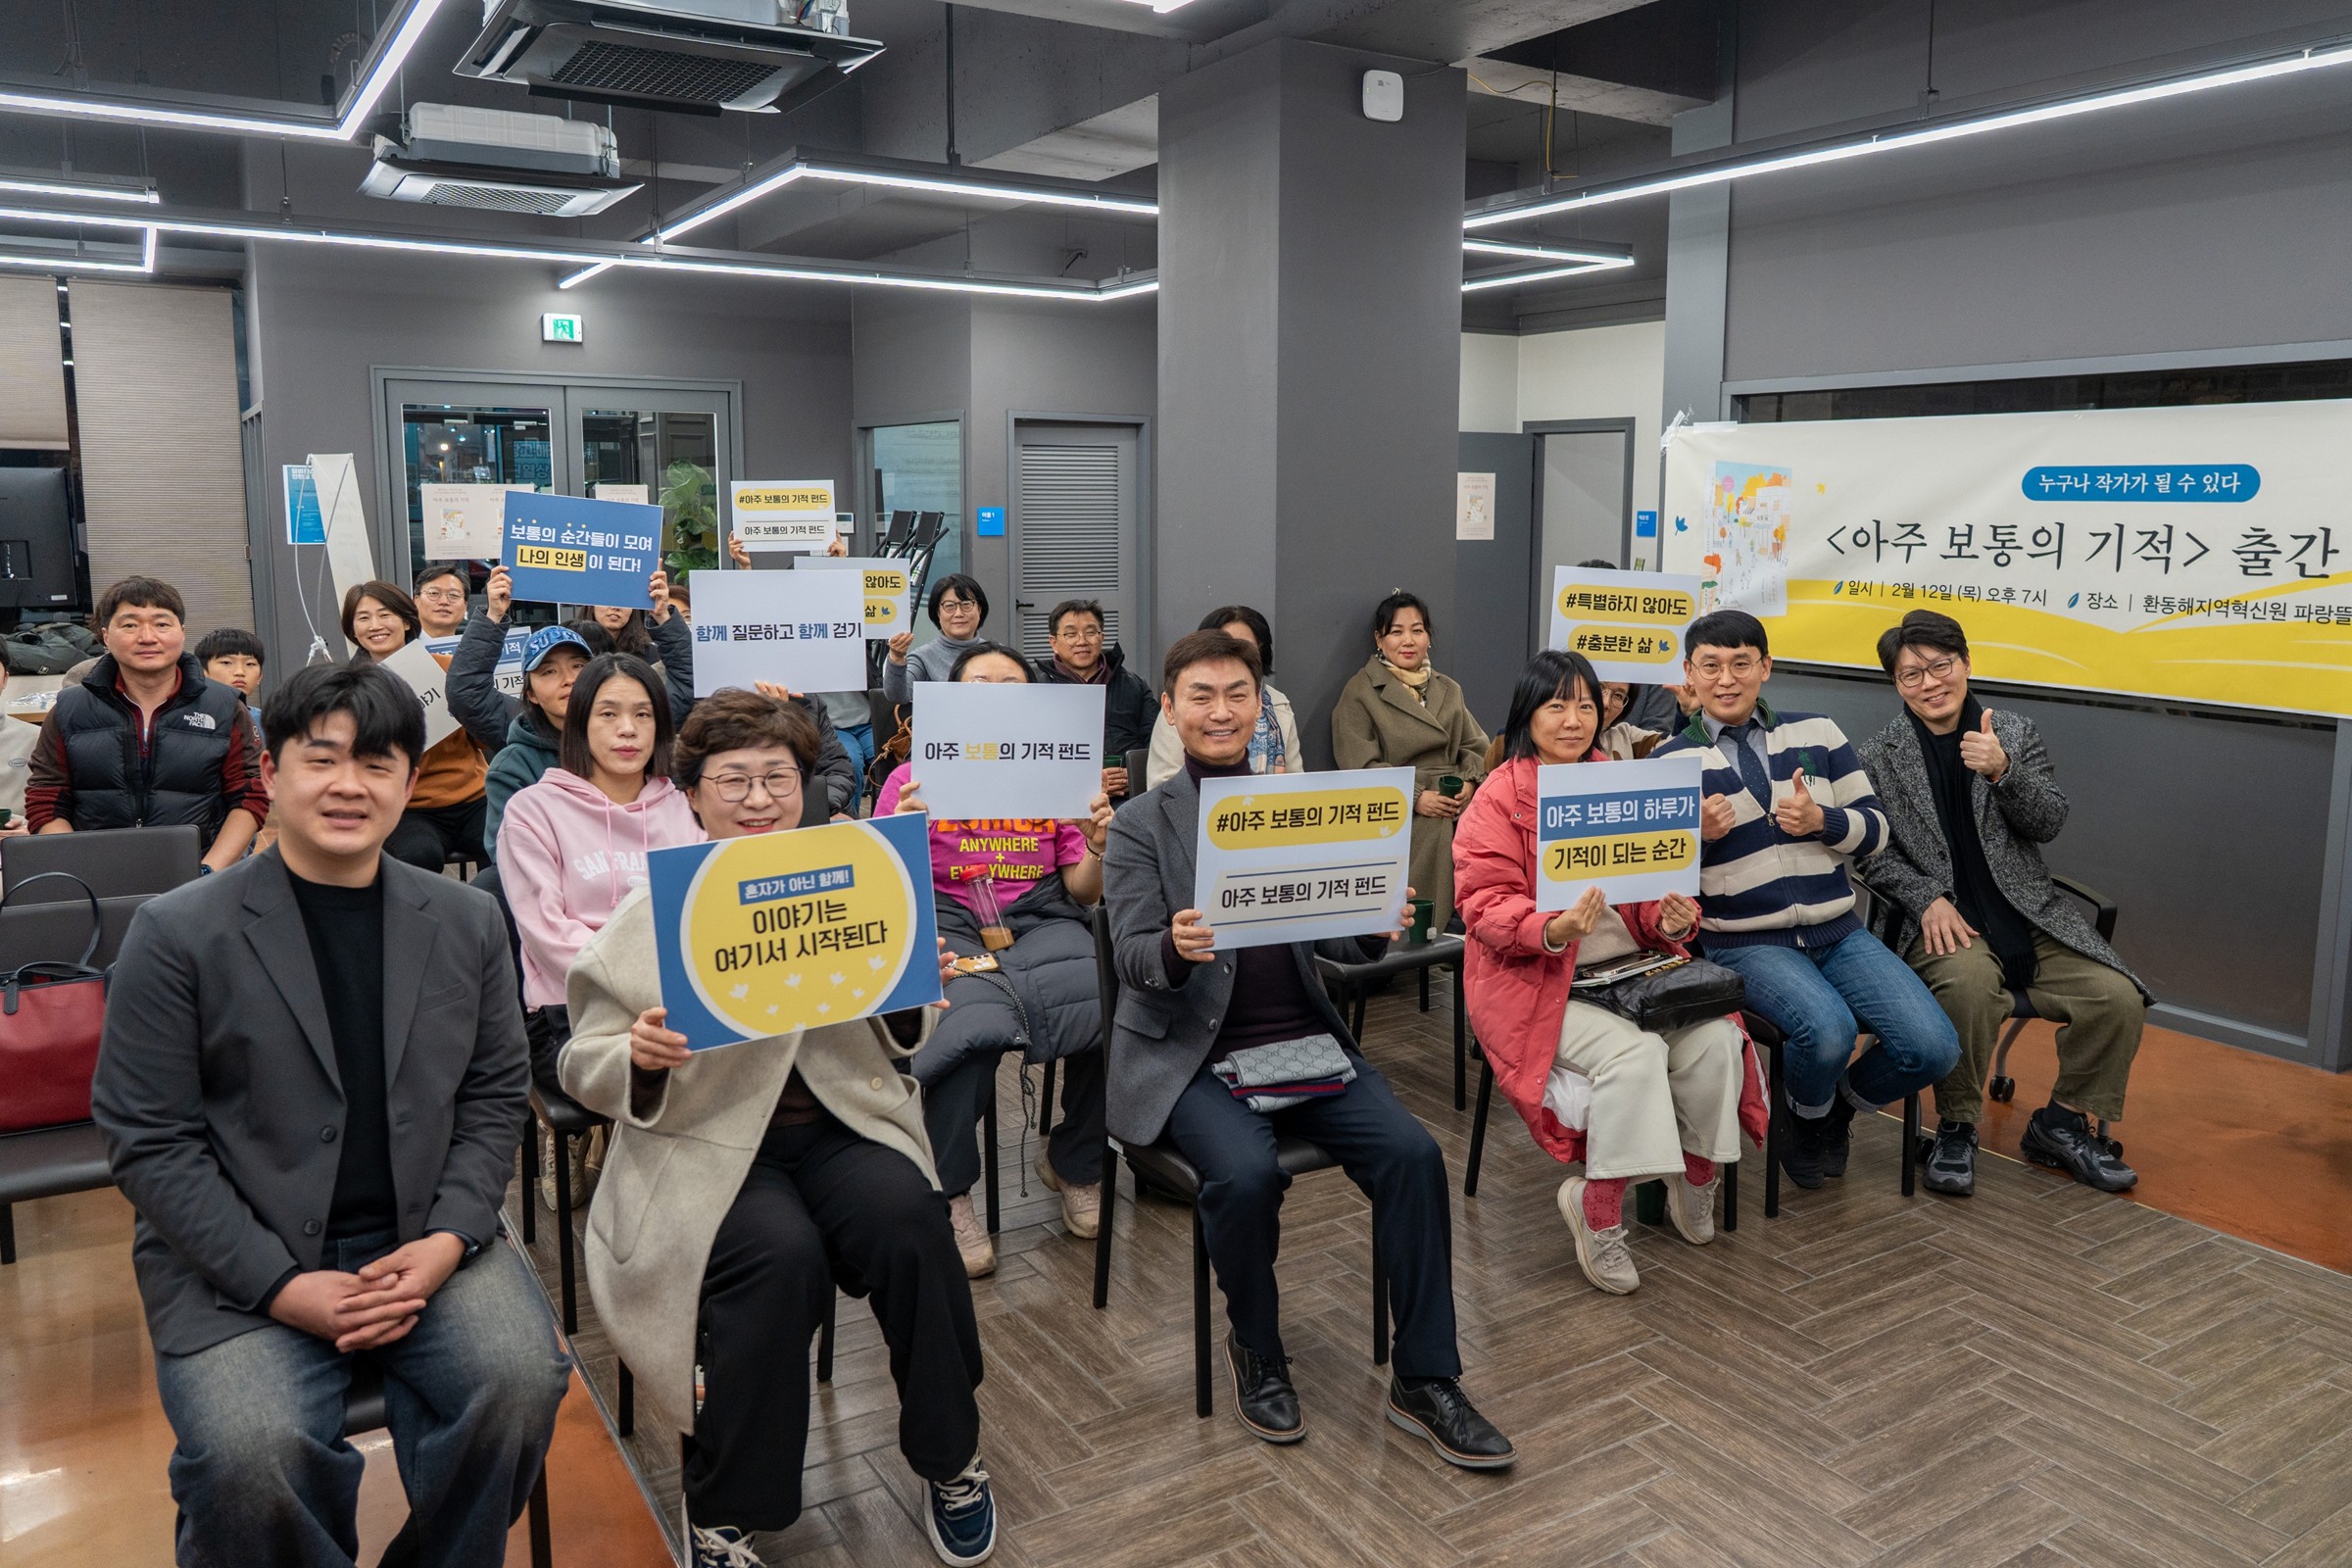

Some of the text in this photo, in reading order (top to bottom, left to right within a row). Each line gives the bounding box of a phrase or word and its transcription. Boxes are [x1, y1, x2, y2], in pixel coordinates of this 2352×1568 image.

[2038, 471, 2241, 494] 누구나 작가가 될 수 있다
[739, 494, 827, 505] #아주 보통의 기적 펀드
[510, 524, 653, 551] 보통의 순간들이 모여
[745, 525, 825, 536] 아주 보통의 기적 펀드
[519, 549, 642, 573] 나의 인생 이 된다!
[1827, 519, 2340, 579] <아주 보통의 기적> 출간
[864, 576, 902, 589] 않아도
[1848, 580, 2047, 606] 일시 2월 12일 (목) 오후 7시
[864, 605, 877, 617] 삶
[1566, 593, 1638, 612] #특별하지
[1642, 597, 1688, 615] 않아도
[2086, 592, 2352, 626] 장소 환동해지역혁신원 파랑뜰
[696, 622, 862, 642] 함께 질문하고 함께 걷기
[1576, 634, 1653, 654] #충분한 삶
[925, 742, 1091, 760] 아주 보통의 기적 펀드
[1216, 802, 1399, 832] #아주 보통의 기적 펀드
[1546, 796, 1695, 828] 아주 보통의 하루가
[959, 837, 1039, 853] ANYWHERE
[1554, 837, 1687, 870] 기적이 되는 순간
[573, 850, 611, 880] SAN
[950, 863, 1044, 880] EVYWHERE
[744, 869, 850, 900] 혼자가 아닌 함께!
[1222, 876, 1386, 908] 아주 보통의 기적 펀드
[753, 900, 847, 934] 이야기는
[714, 920, 888, 973] 여기서 시작된다
